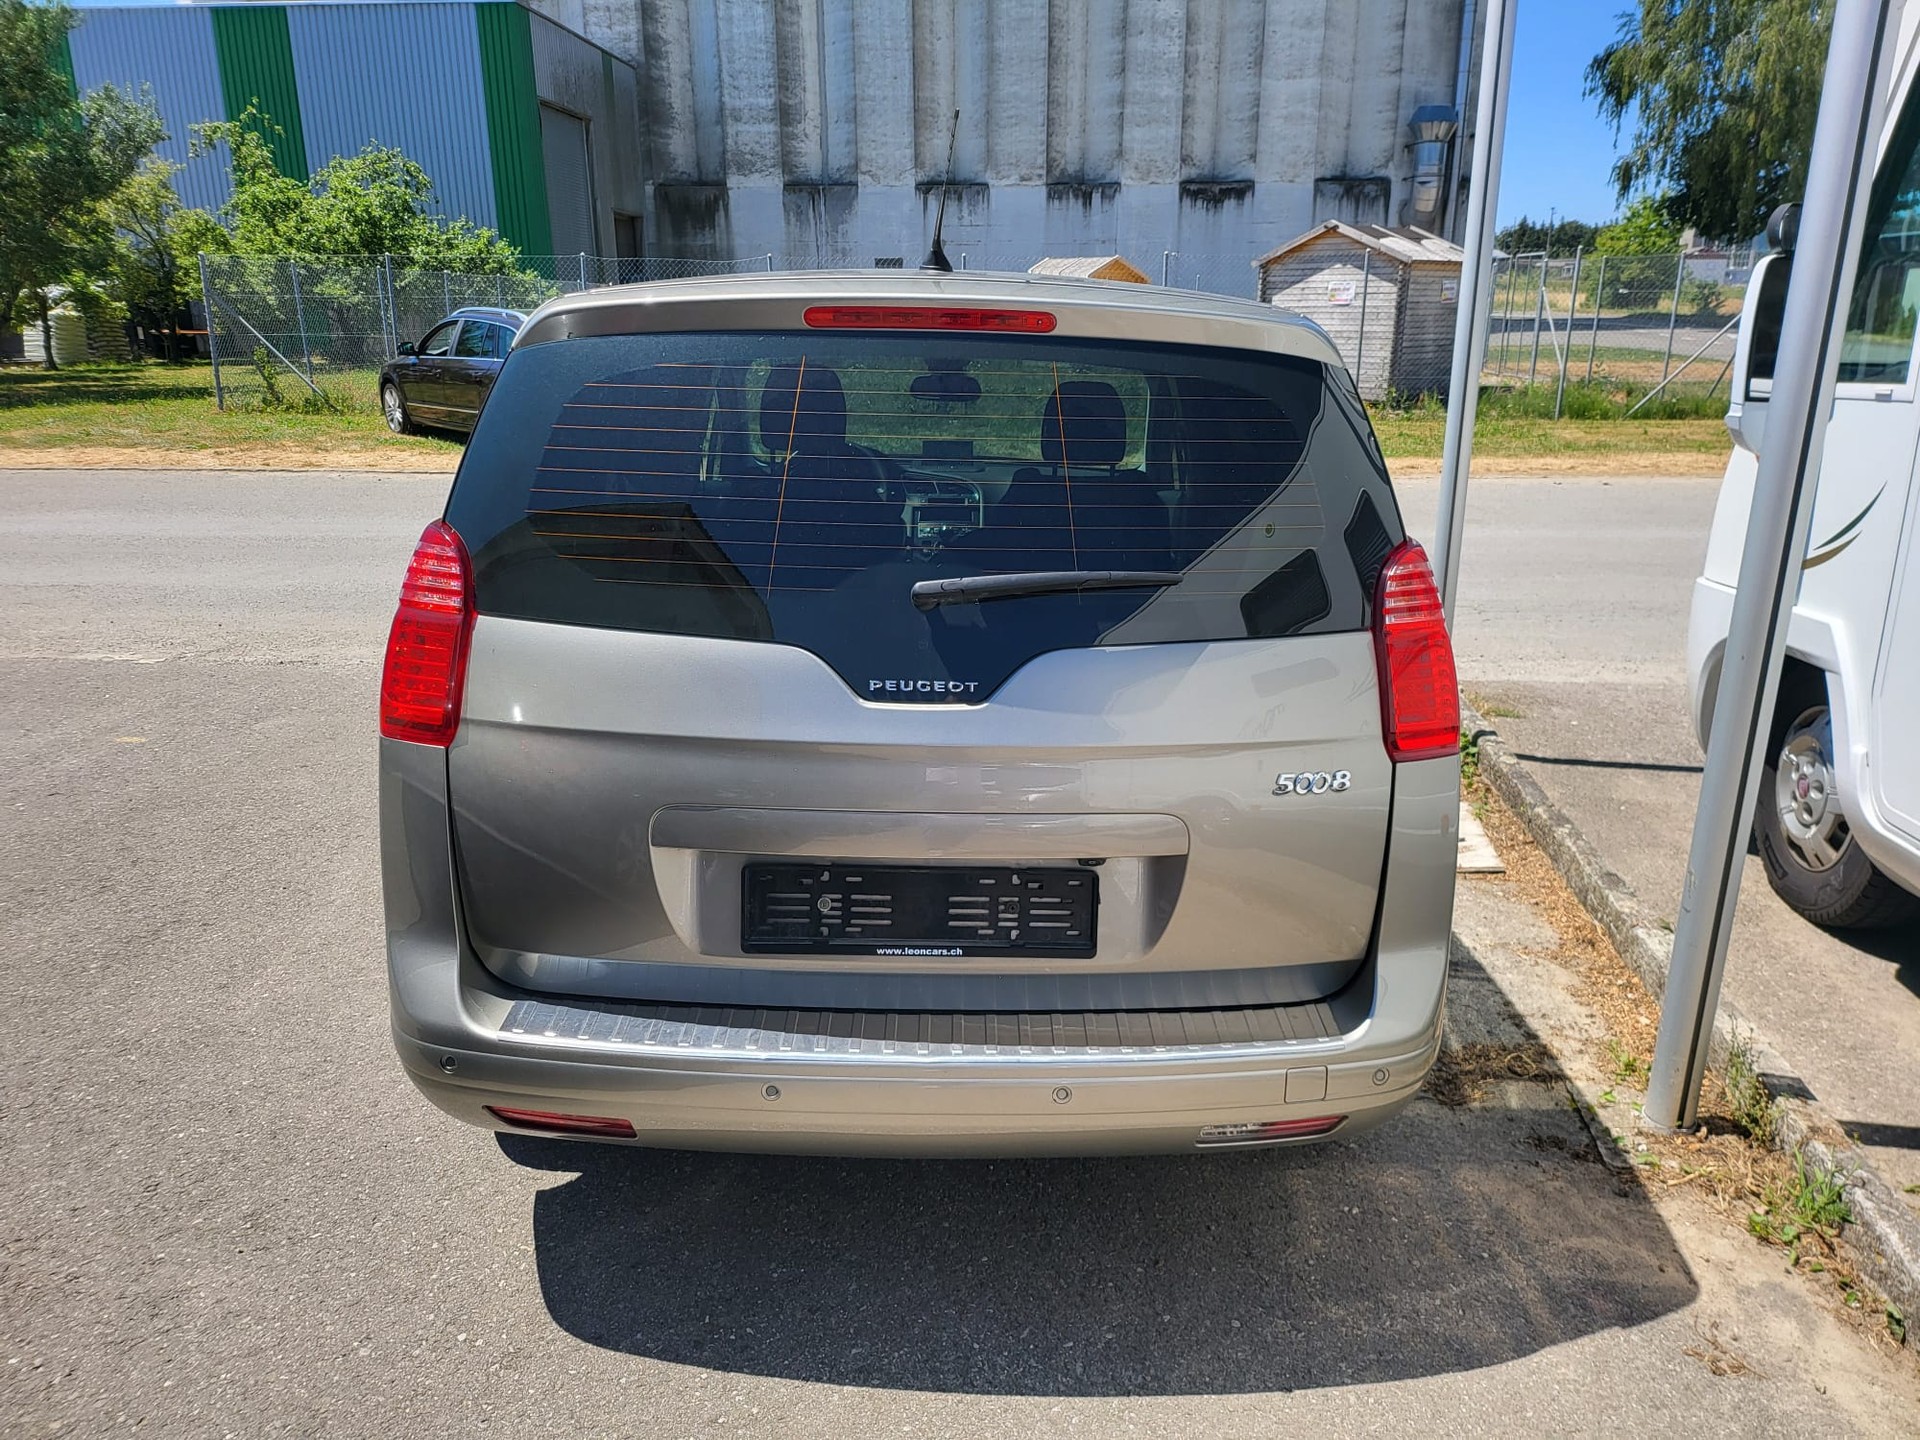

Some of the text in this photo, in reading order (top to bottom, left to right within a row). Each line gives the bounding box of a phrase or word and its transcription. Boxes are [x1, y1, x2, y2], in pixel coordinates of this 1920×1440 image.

[868, 679, 979, 693] PEUGEOT
[1272, 769, 1352, 796] 5008
[876, 947, 963, 956] www.leoncars.ch
